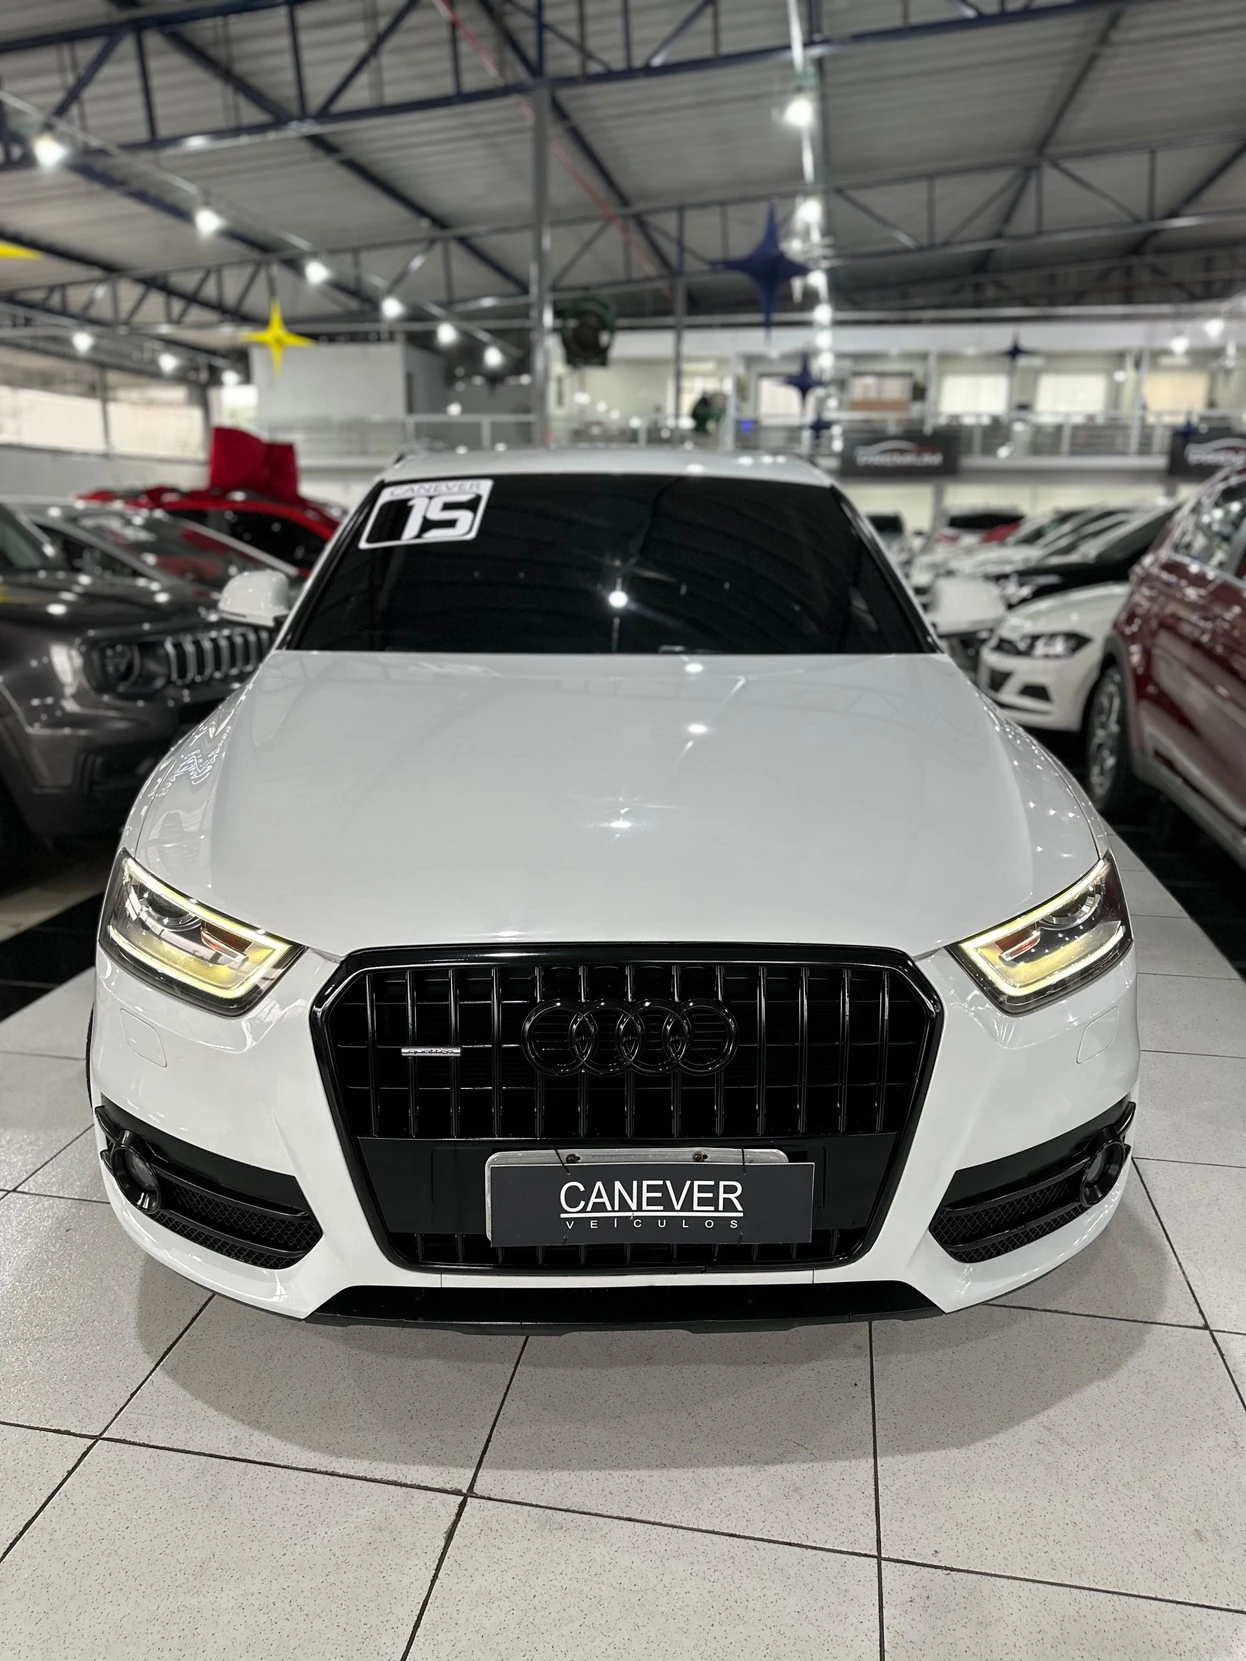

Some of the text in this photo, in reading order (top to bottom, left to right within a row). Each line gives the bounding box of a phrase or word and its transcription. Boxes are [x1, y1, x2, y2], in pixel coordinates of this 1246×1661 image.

[390, 481, 481, 497] CANEVER
[401, 493, 477, 540] 15
[560, 1180, 744, 1213] CANEVER
[566, 1218, 738, 1229] VEÍCULOS
